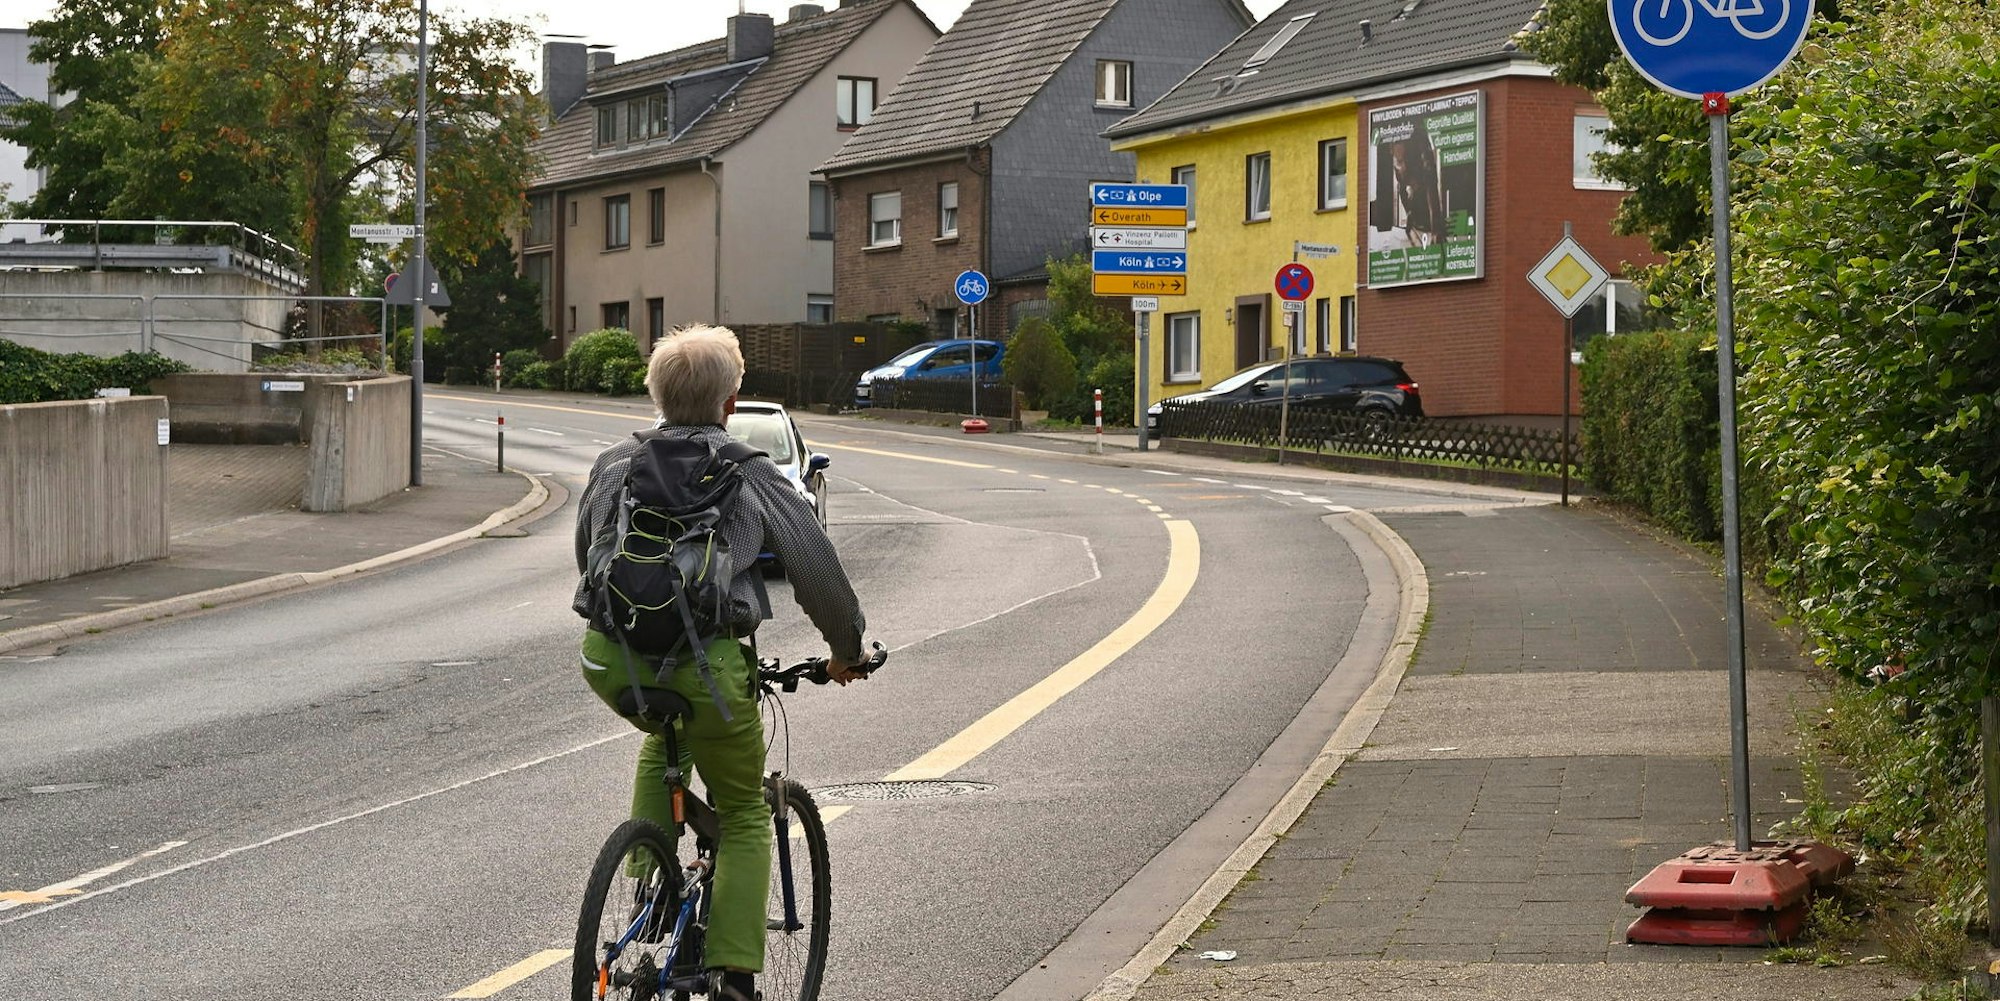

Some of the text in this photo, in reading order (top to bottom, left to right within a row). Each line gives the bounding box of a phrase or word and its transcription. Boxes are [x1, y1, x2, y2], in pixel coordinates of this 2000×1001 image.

[1372, 95, 1477, 122] VINYLBODEN PARKETT LAMINAT TEPPICH
[1427, 111, 1475, 130] Geprüfte Qualität
[1434, 131, 1474, 146] durch eigenes
[1139, 191, 1162, 203] Olpe
[1111, 211, 1151, 222] Overath
[351, 227, 393, 236] Montanusstr.
[1446, 244, 1475, 258] Lieferung
[1119, 256, 1142, 267] Köln
[1446, 258, 1475, 270] KOSTENLOS
[1133, 280, 1155, 289] Köln
